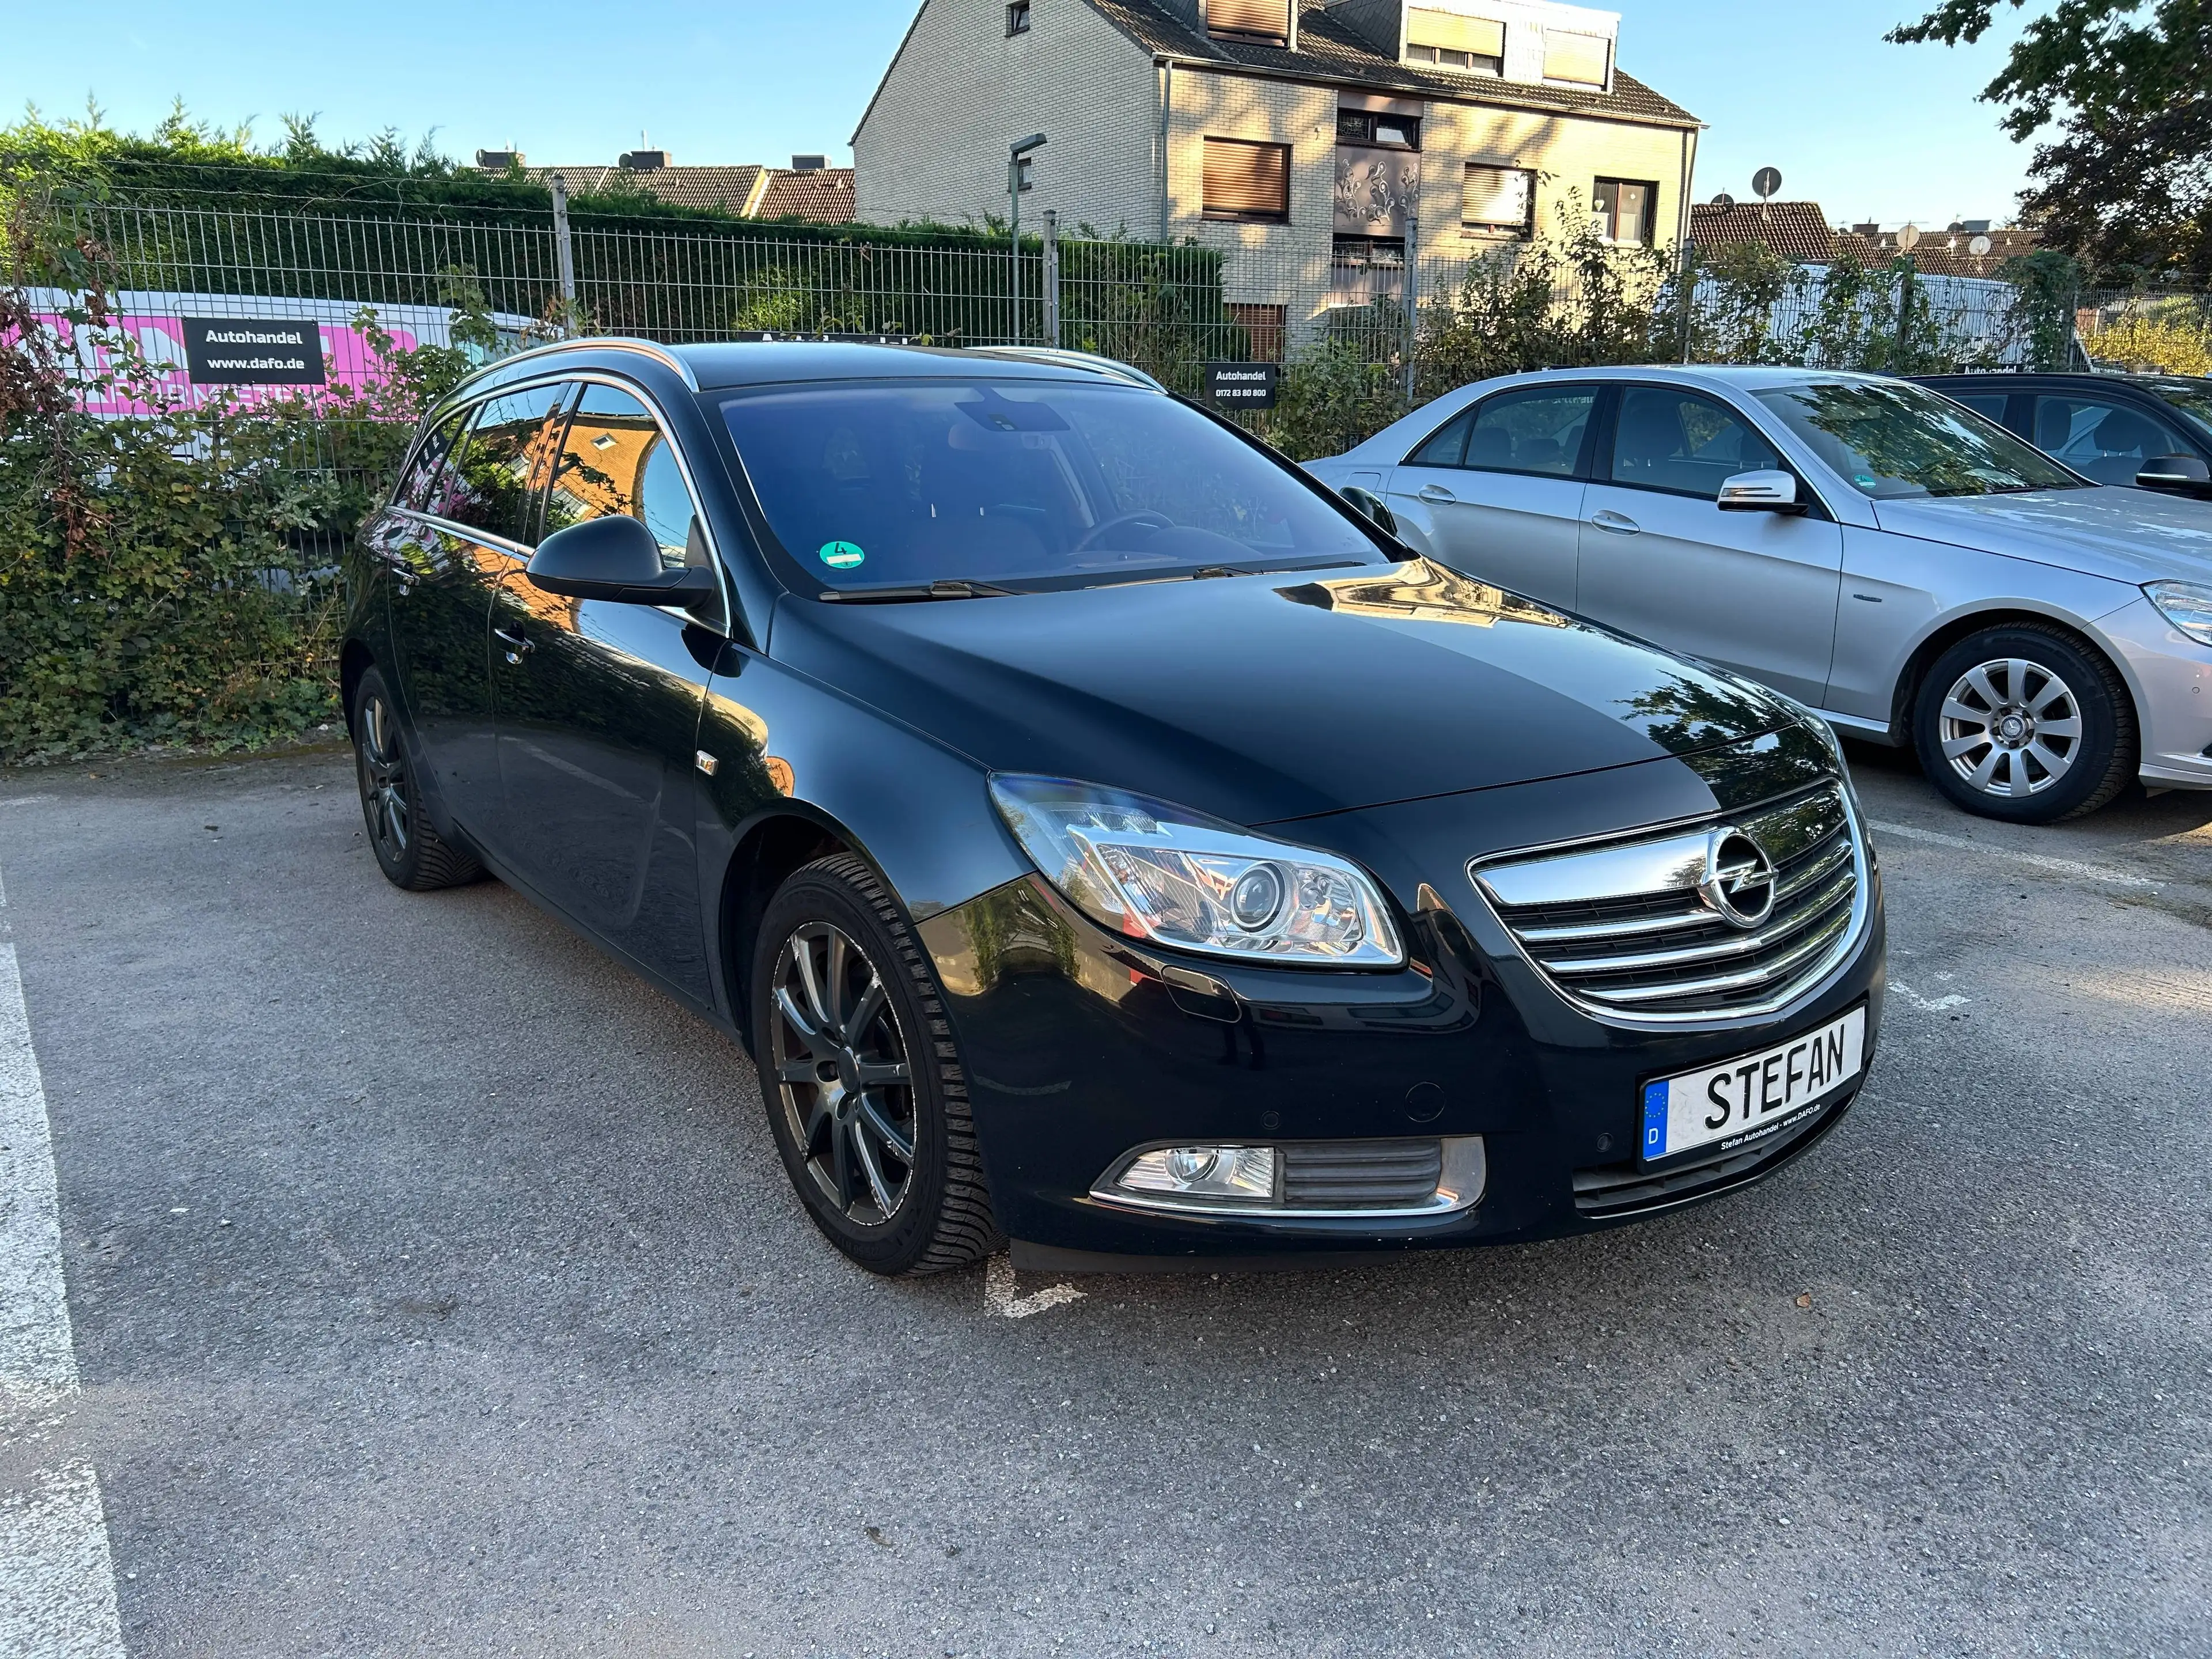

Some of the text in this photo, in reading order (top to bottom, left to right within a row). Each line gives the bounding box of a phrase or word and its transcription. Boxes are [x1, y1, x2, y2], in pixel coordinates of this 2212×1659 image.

[206, 329, 303, 344] Autohandel
[207, 357, 305, 369] www.dafo.de
[1964, 365, 2017, 374] Autoandel
[1215, 370, 1266, 380] Autohandel
[834, 542, 847, 554] 4
[1705, 1024, 1844, 1130] STEFAN
[1721, 1137, 1743, 1150] Stefan
[1744, 1122, 1779, 1142] Autohandel
[1783, 1103, 1820, 1127] www.DAFO.de
[1648, 1127, 1658, 1145] D
